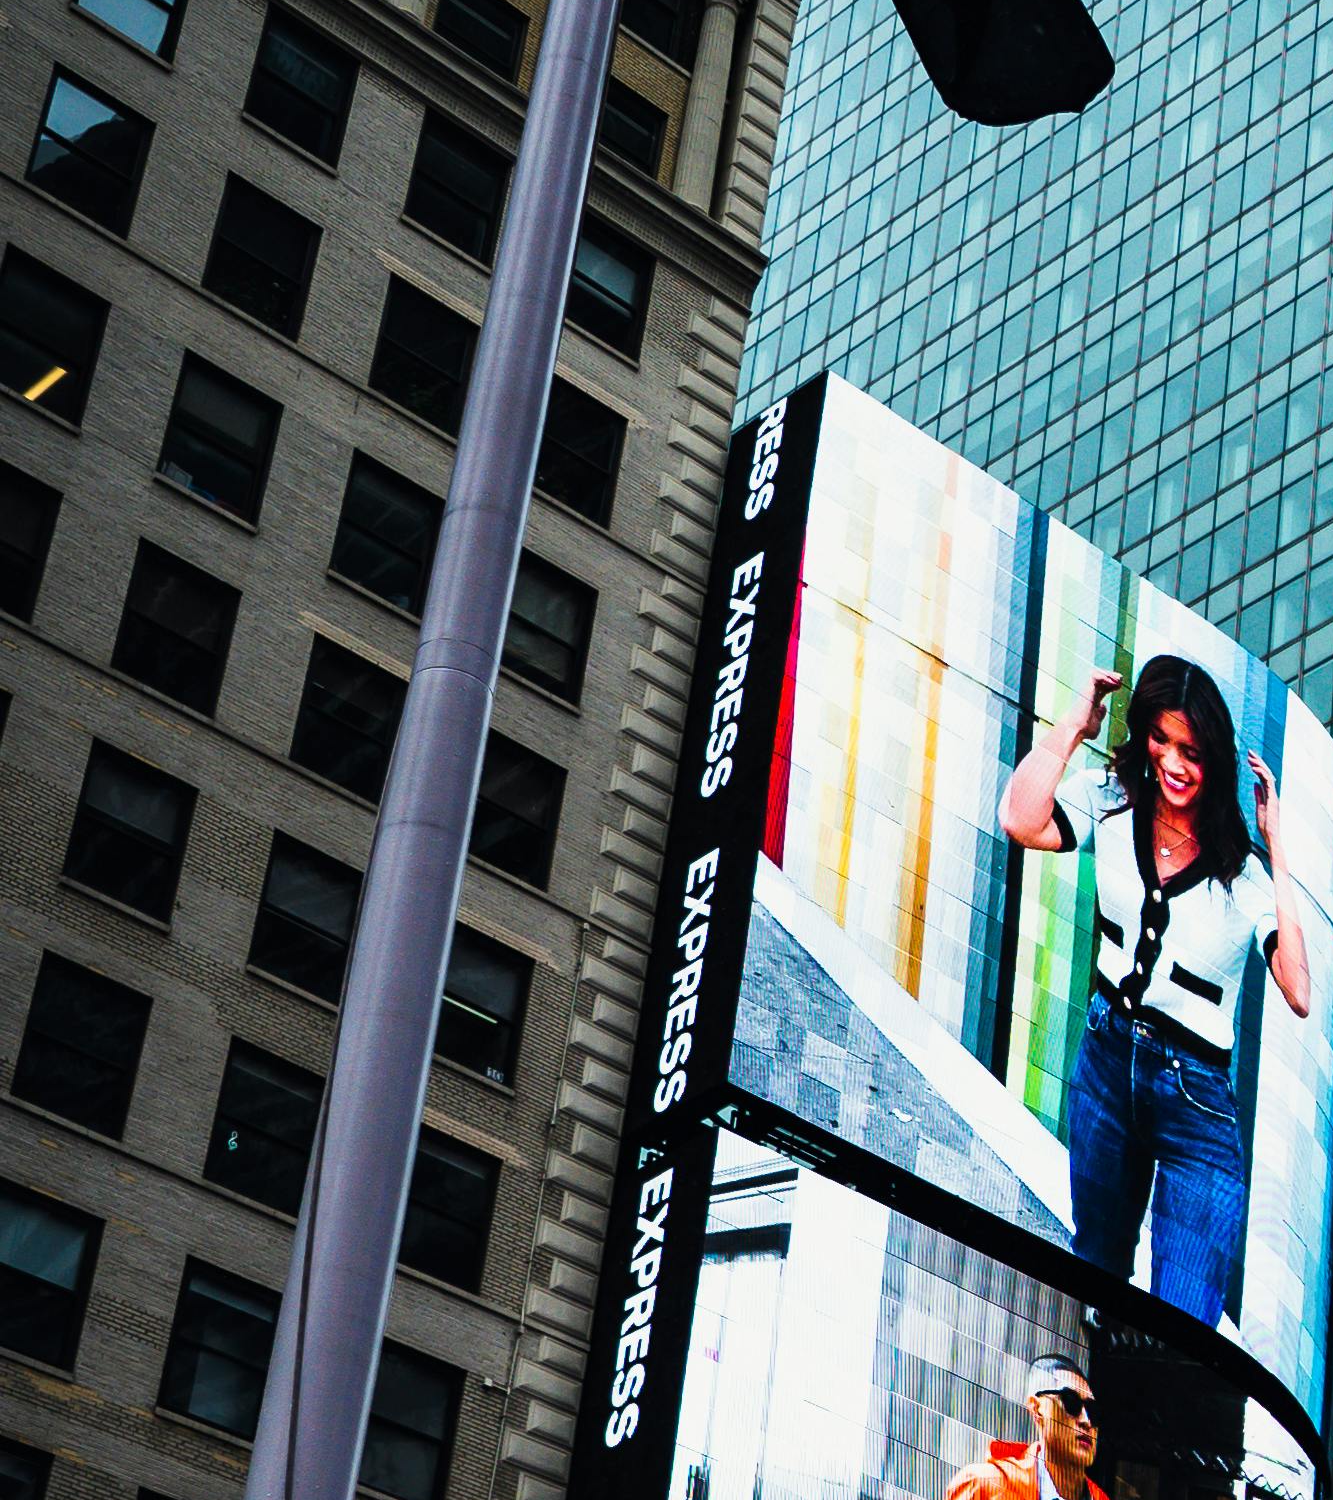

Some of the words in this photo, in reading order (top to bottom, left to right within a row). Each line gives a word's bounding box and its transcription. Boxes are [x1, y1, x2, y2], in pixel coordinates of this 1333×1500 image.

[700, 550, 765, 799] EXPRESS
[653, 846, 721, 1114] EXPRESS
[604, 1167, 674, 1449] EXPRESS
